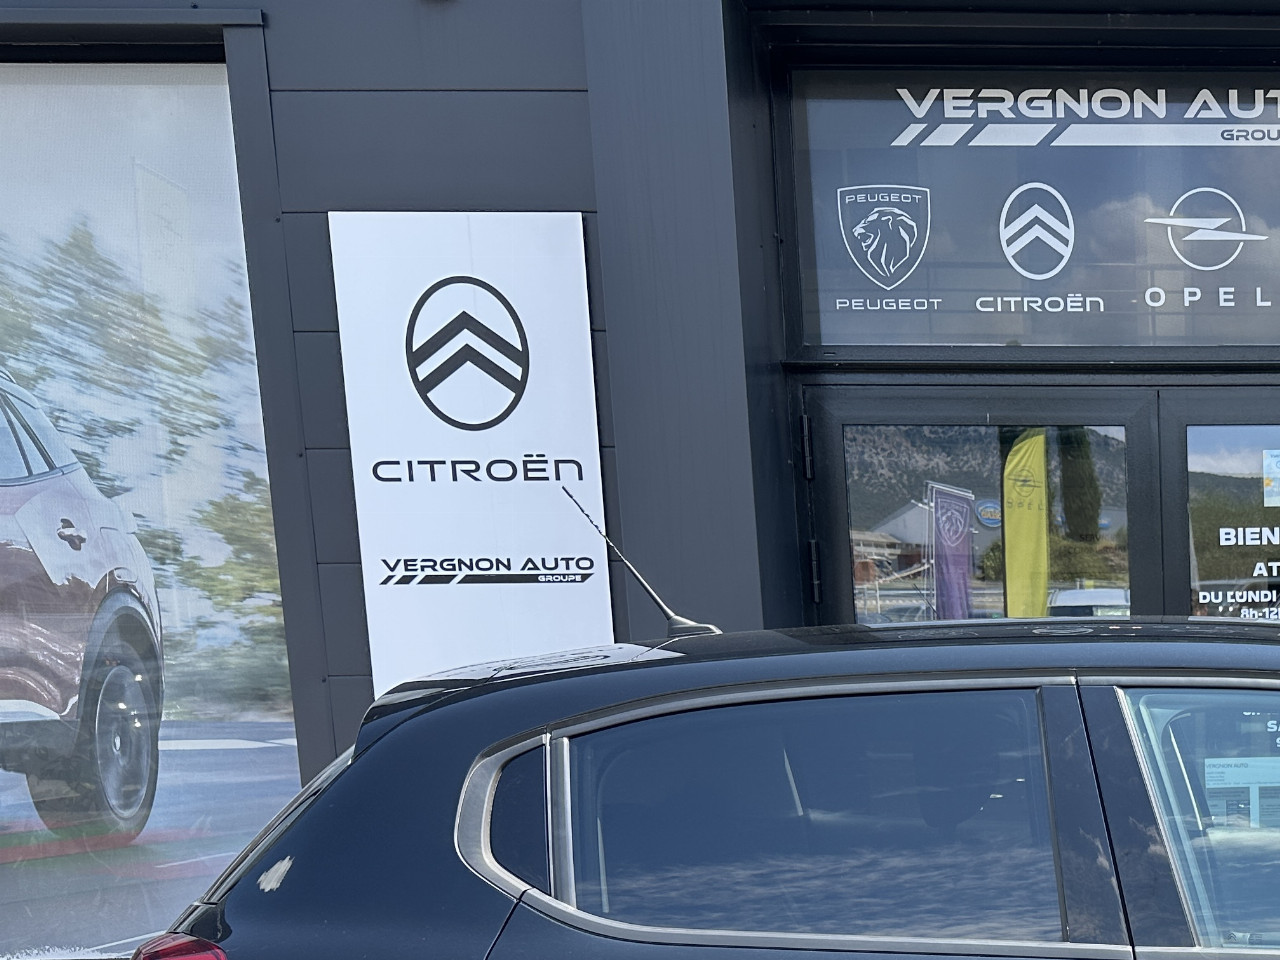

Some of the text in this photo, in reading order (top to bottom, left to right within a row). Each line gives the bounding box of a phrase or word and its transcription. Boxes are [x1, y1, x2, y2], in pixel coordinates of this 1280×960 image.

[897, 87, 1166, 119] VERGNON
[844, 192, 923, 204] PEUGEOT
[835, 297, 943, 311] PEUGEOT
[975, 292, 1105, 313] CITROËN
[1144, 287, 1273, 308] OPEL
[371, 453, 585, 483] CITROËN
[380, 557, 595, 573] VERGNON AUTO
[537, 574, 583, 583] GROUPE
[1198, 591, 1223, 603] DU
[1227, 590, 1277, 603] LUNDI
